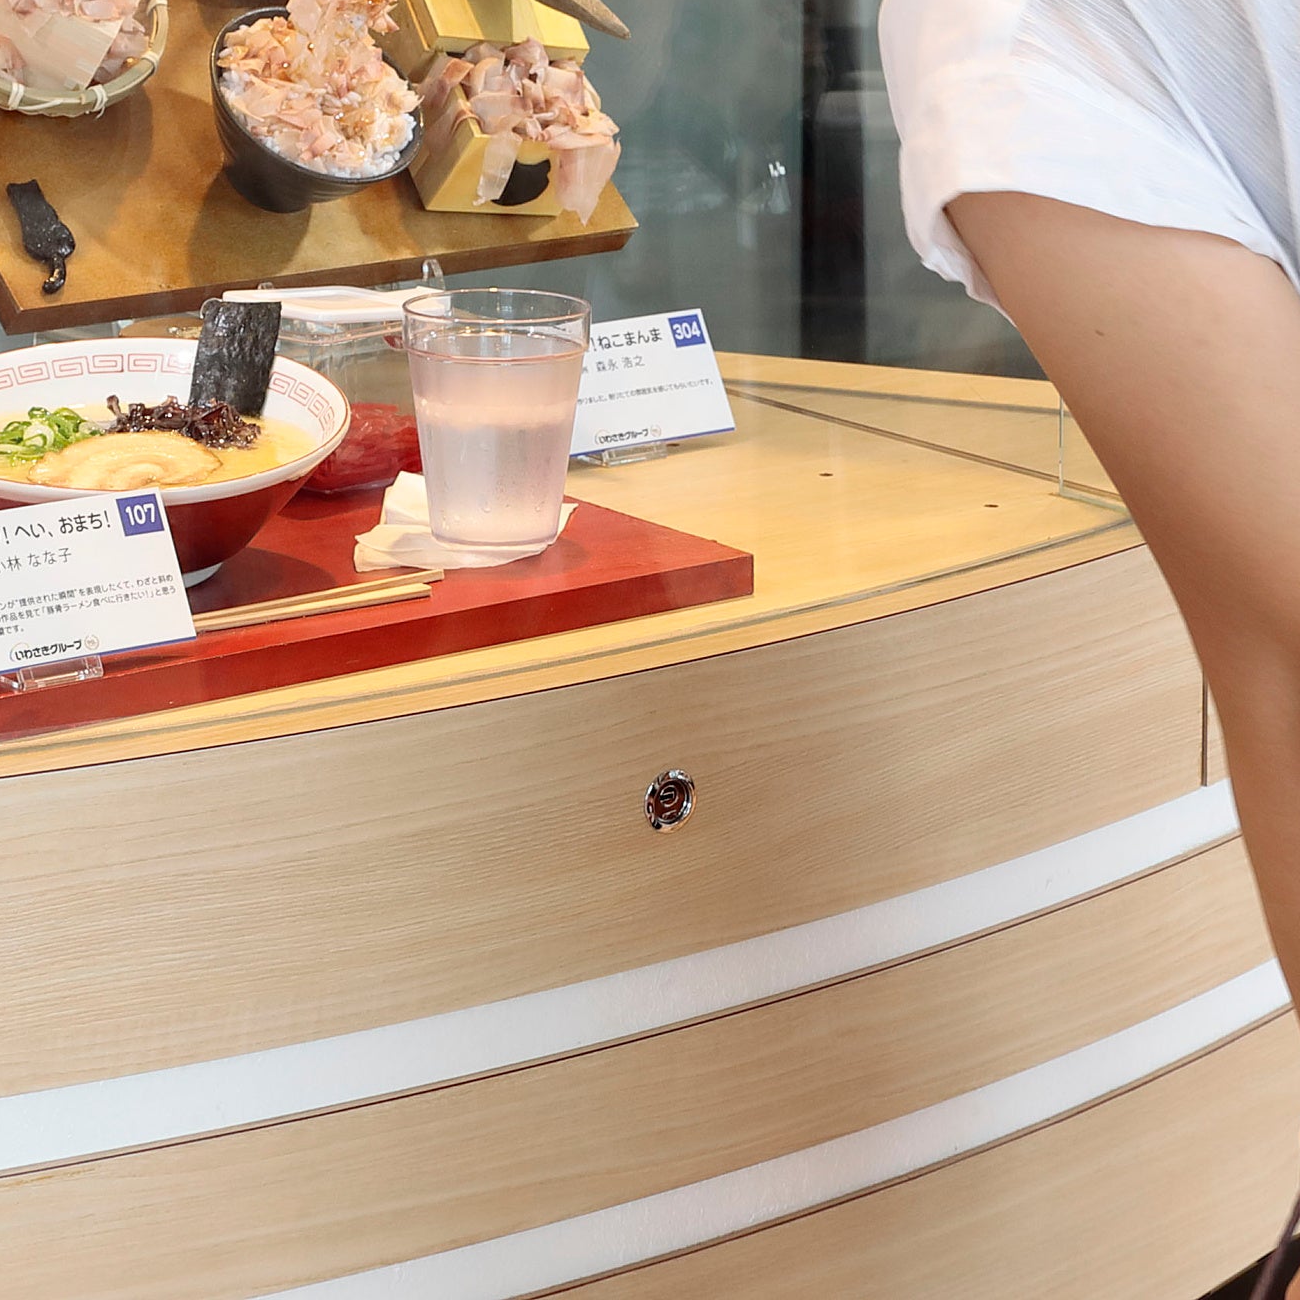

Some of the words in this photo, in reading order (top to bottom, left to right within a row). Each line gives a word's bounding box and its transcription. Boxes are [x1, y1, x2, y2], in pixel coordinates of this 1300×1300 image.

[673, 321, 701, 340] 304
[125, 503, 156, 526] 107
[15, 639, 82, 660] いわさきグループ
